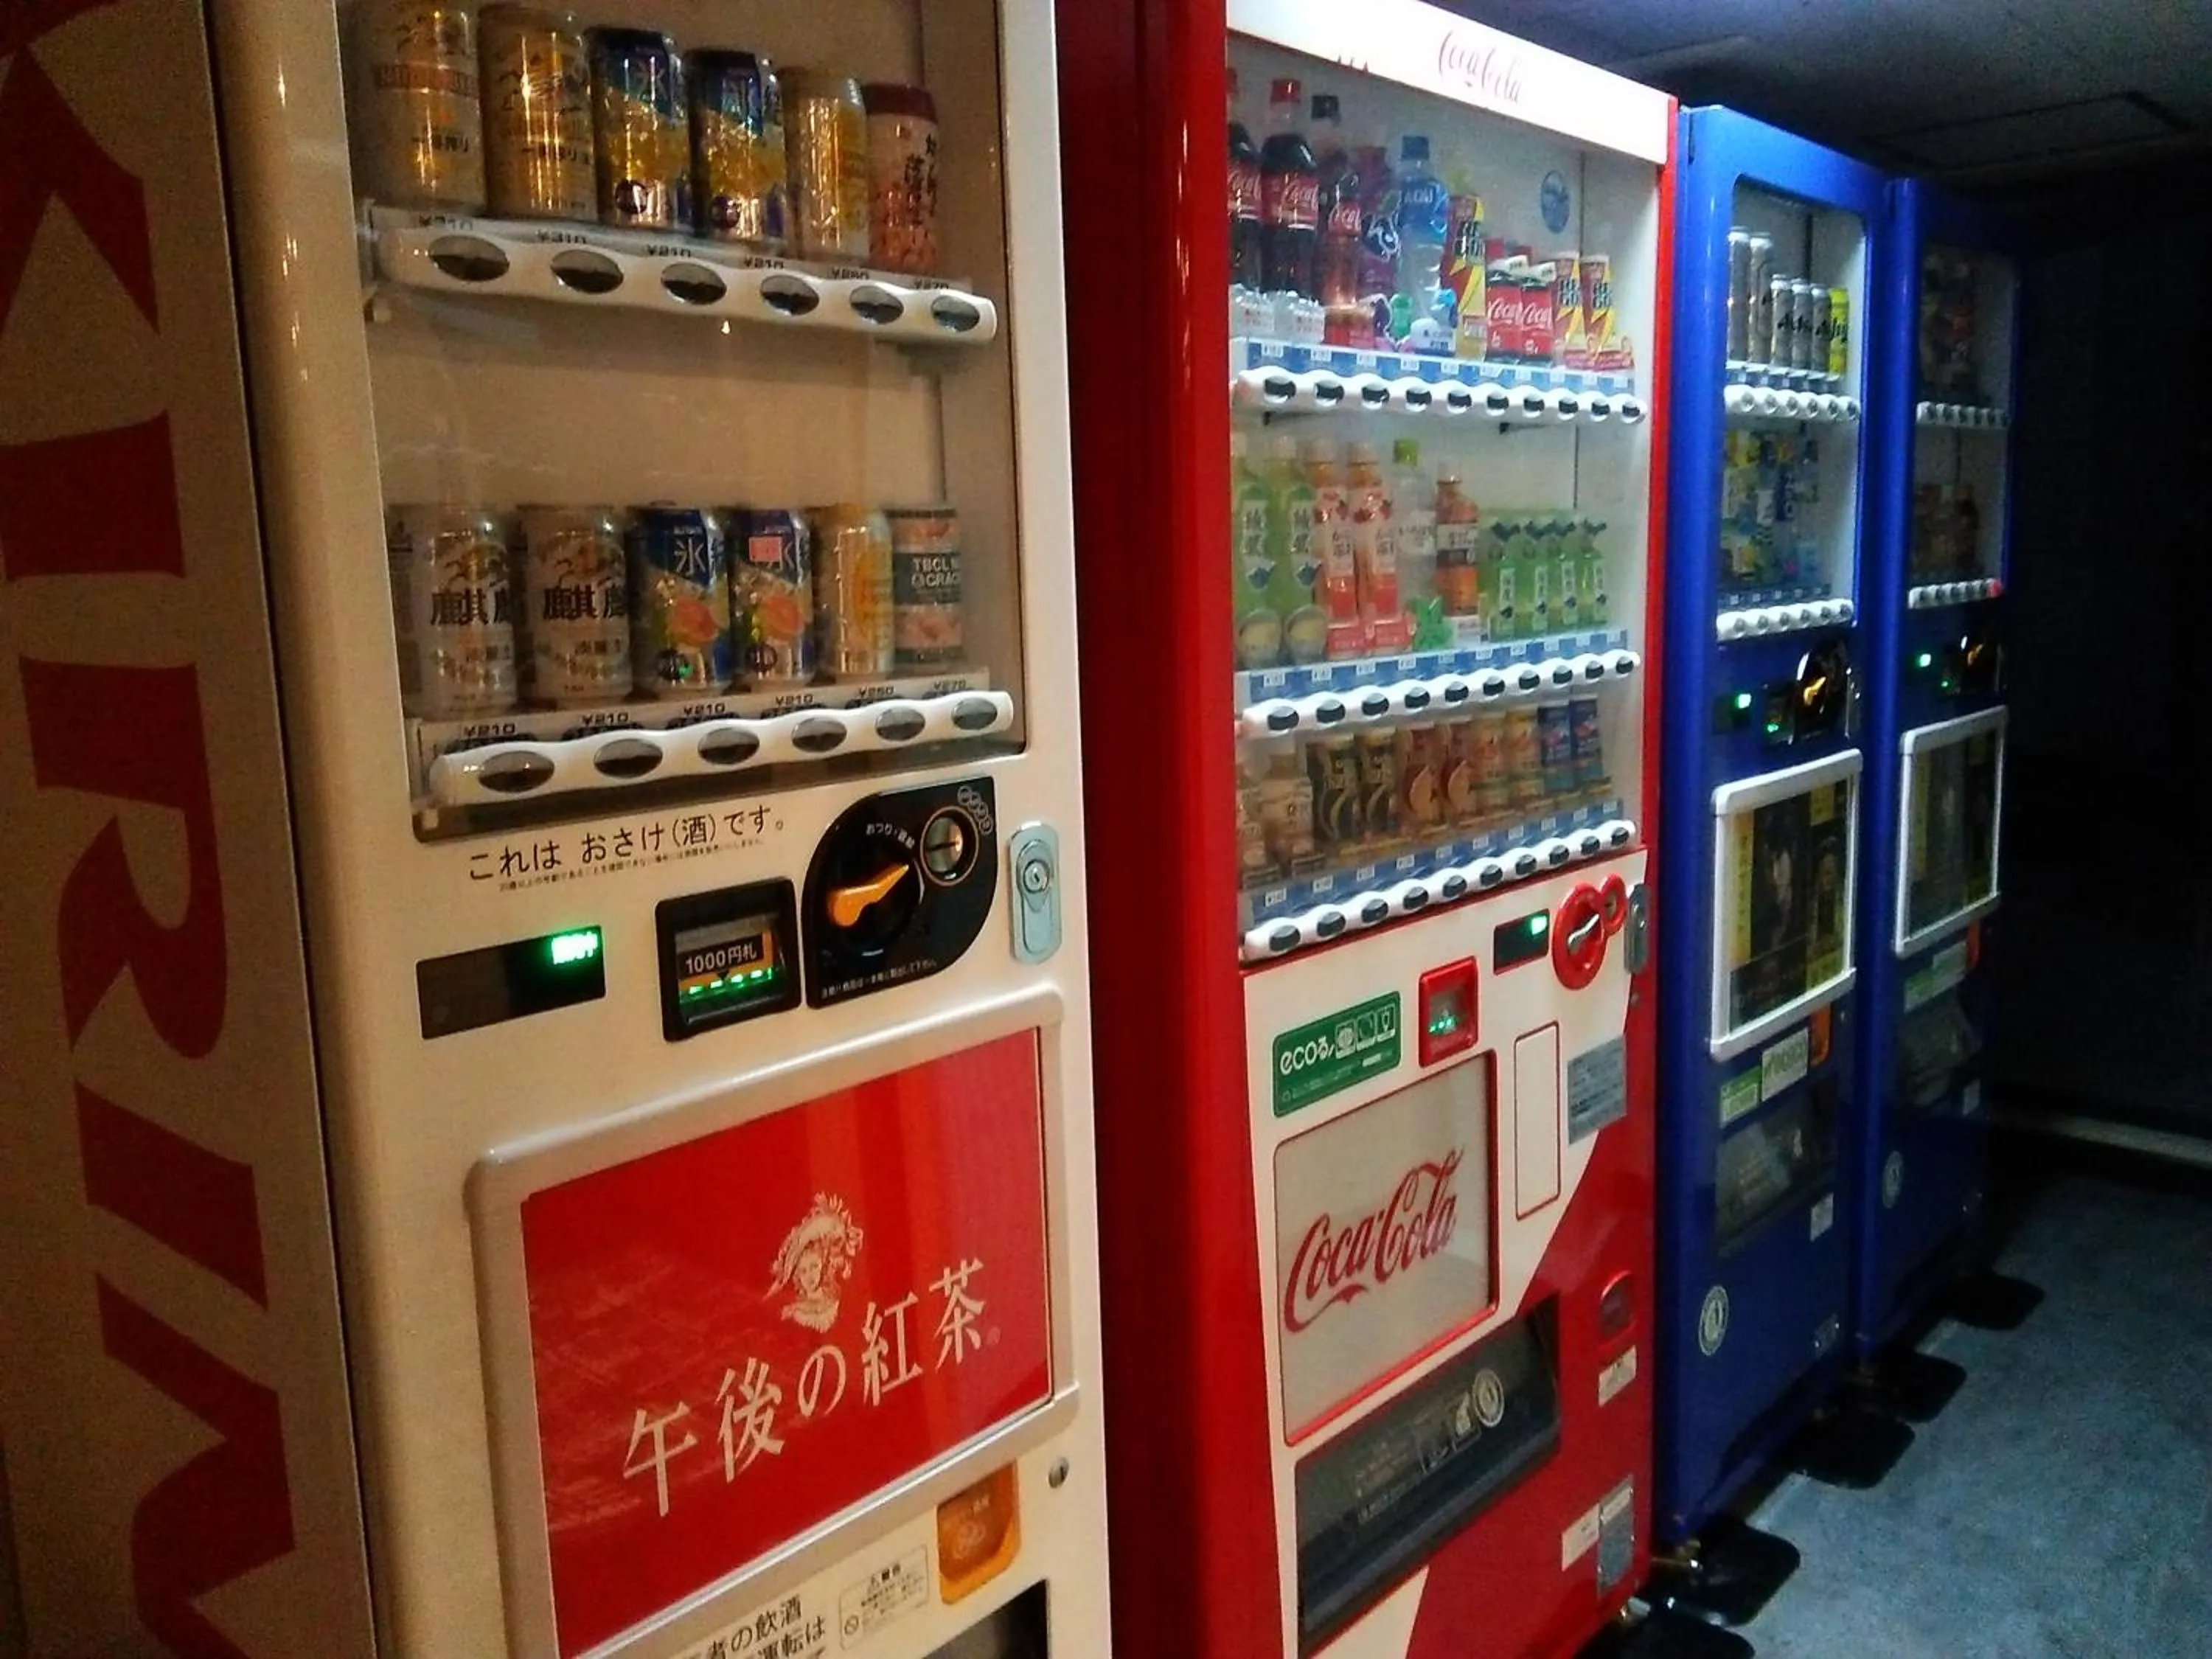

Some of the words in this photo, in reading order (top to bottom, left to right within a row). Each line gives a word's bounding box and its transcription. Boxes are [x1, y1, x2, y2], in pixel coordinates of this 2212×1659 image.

[582, 711, 630, 726] ¥210
[684, 702, 726, 715] ¥210
[465, 723, 516, 737] ¥210
[469, 839, 562, 880] これは
[686, 942, 758, 974] 1000円札
[623, 1258, 985, 1517] 午後の紅茶
